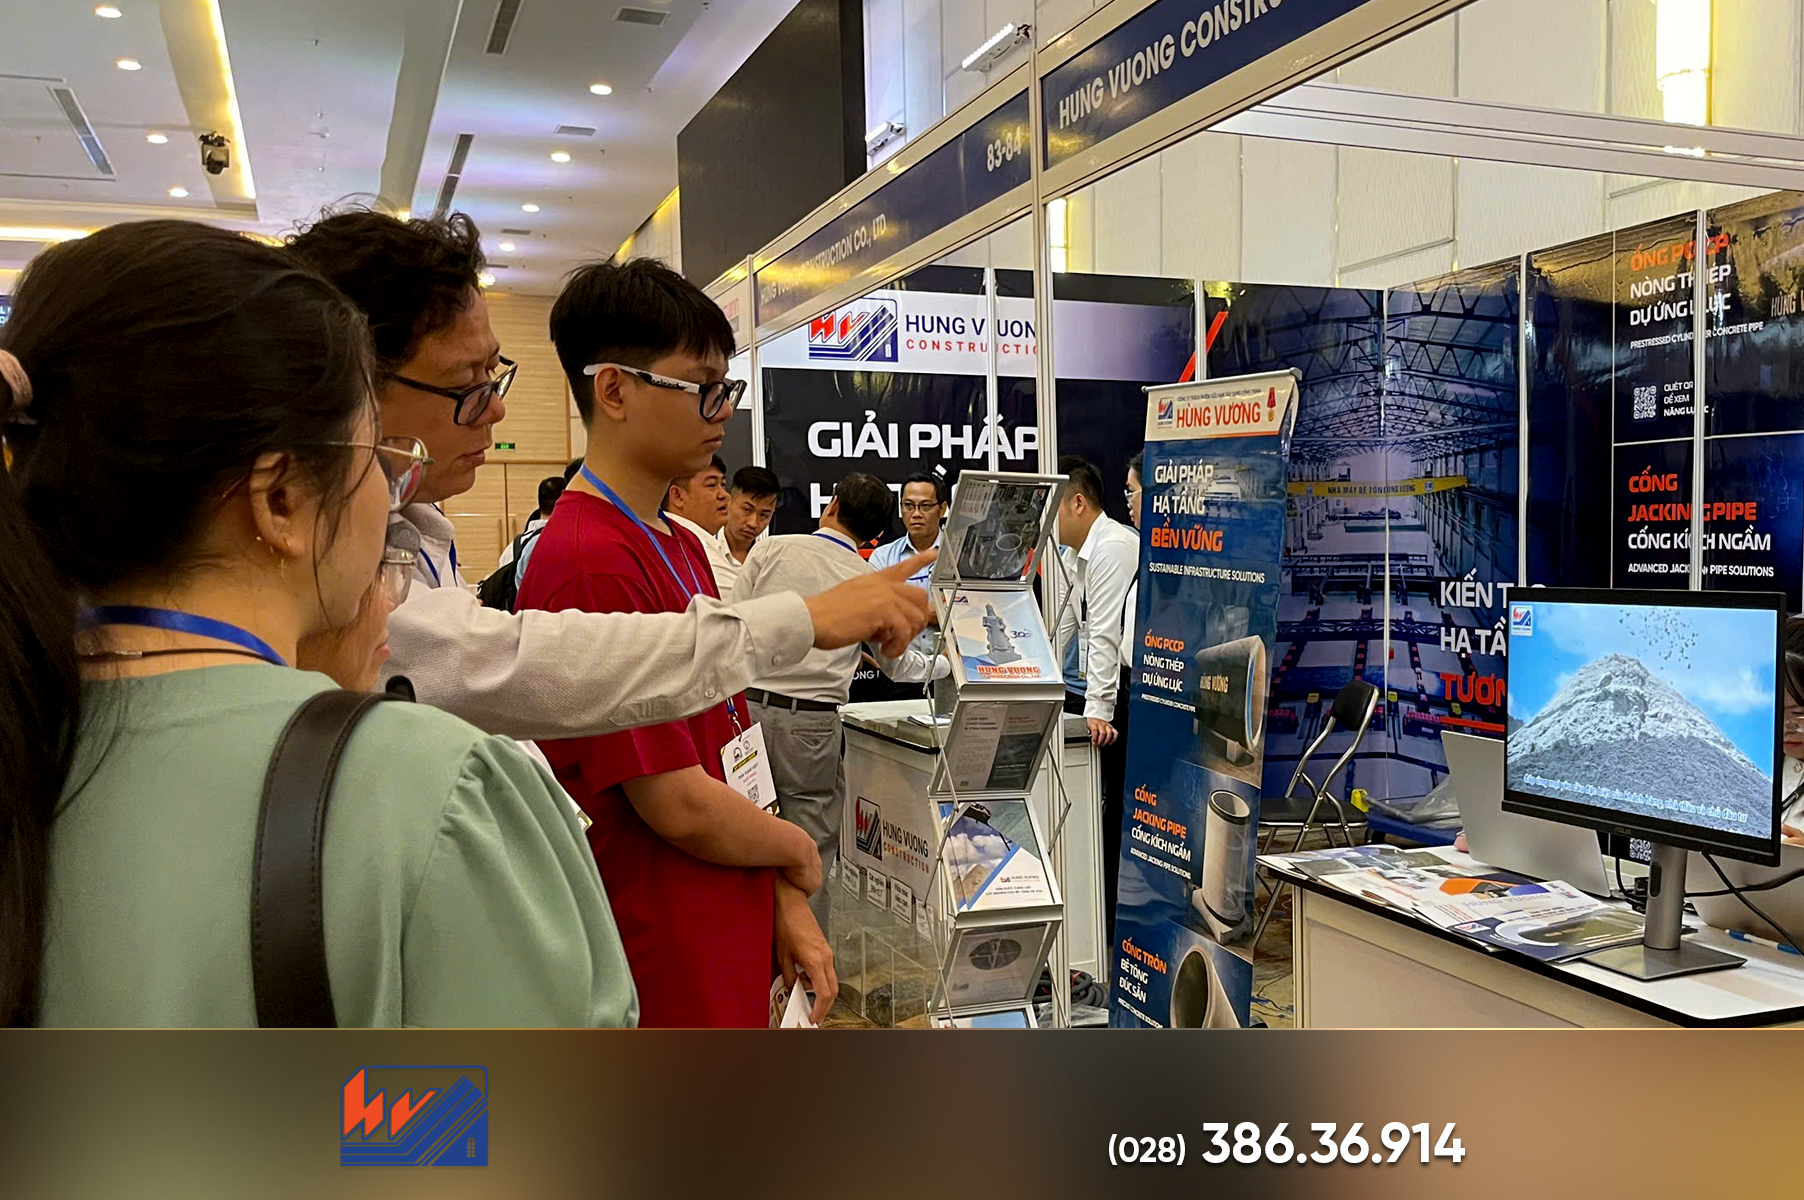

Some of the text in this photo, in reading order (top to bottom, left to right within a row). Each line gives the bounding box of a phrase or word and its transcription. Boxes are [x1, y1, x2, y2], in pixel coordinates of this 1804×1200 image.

[1059, 0, 1282, 130] HUNG VUONG CONSTR
[987, 126, 1022, 172] 83-84
[873, 213, 886, 241] LTD
[1631, 243, 1668, 271] ỐNG
[1630, 275, 1675, 299] NÒNG
[906, 315, 1037, 338] HUNG VUON
[1630, 304, 1651, 327] DỰ
[1654, 300, 1687, 321] ỨNG
[906, 339, 1037, 354] CONSTRUCTI
[1630, 336, 1671, 349] PRESTRESSED
[1713, 323, 1748, 337] CONCRETE
[1748, 321, 1764, 332] PIPE
[1176, 402, 1261, 428] HÙNG VƯƠNG
[808, 410, 1038, 460] GIẢI PHÁP
[1155, 458, 1213, 484] GIẢI PHÁP
[1629, 465, 1678, 492] CỐNG
[1153, 486, 1206, 518] HẠ TẦNG
[1713, 502, 1757, 521] PIPE
[1151, 517, 1224, 552] BỀN VỮNG
[1628, 525, 1671, 549] CỐNG
[1719, 524, 1771, 551] NGẦM
[1149, 562, 1266, 584] SUSTAINABLE INFRASTRUCTURE SOLUTIONS
[1628, 563, 1669, 574] ADVANCED
[1710, 564, 1728, 576] PIPE
[1728, 565, 1774, 577] SOLUTIONS
[1440, 567, 1493, 608] KIẾN
[1145, 628, 1184, 653] ỐNG PCCP
[1440, 615, 1507, 658] HẠ TẦ
[1143, 652, 1184, 673] NÒNG THÉP
[1142, 671, 1183, 693] DỰ ỨNG LỰC
[1134, 784, 1158, 807] CỐNG
[1133, 807, 1187, 839] JACKING PIPE
[883, 820, 929, 858] HUNG VUONG
[1131, 824, 1192, 862] CỐNG KÍCH NGẦM
[1122, 937, 1167, 975] CỐNG TRÒN
